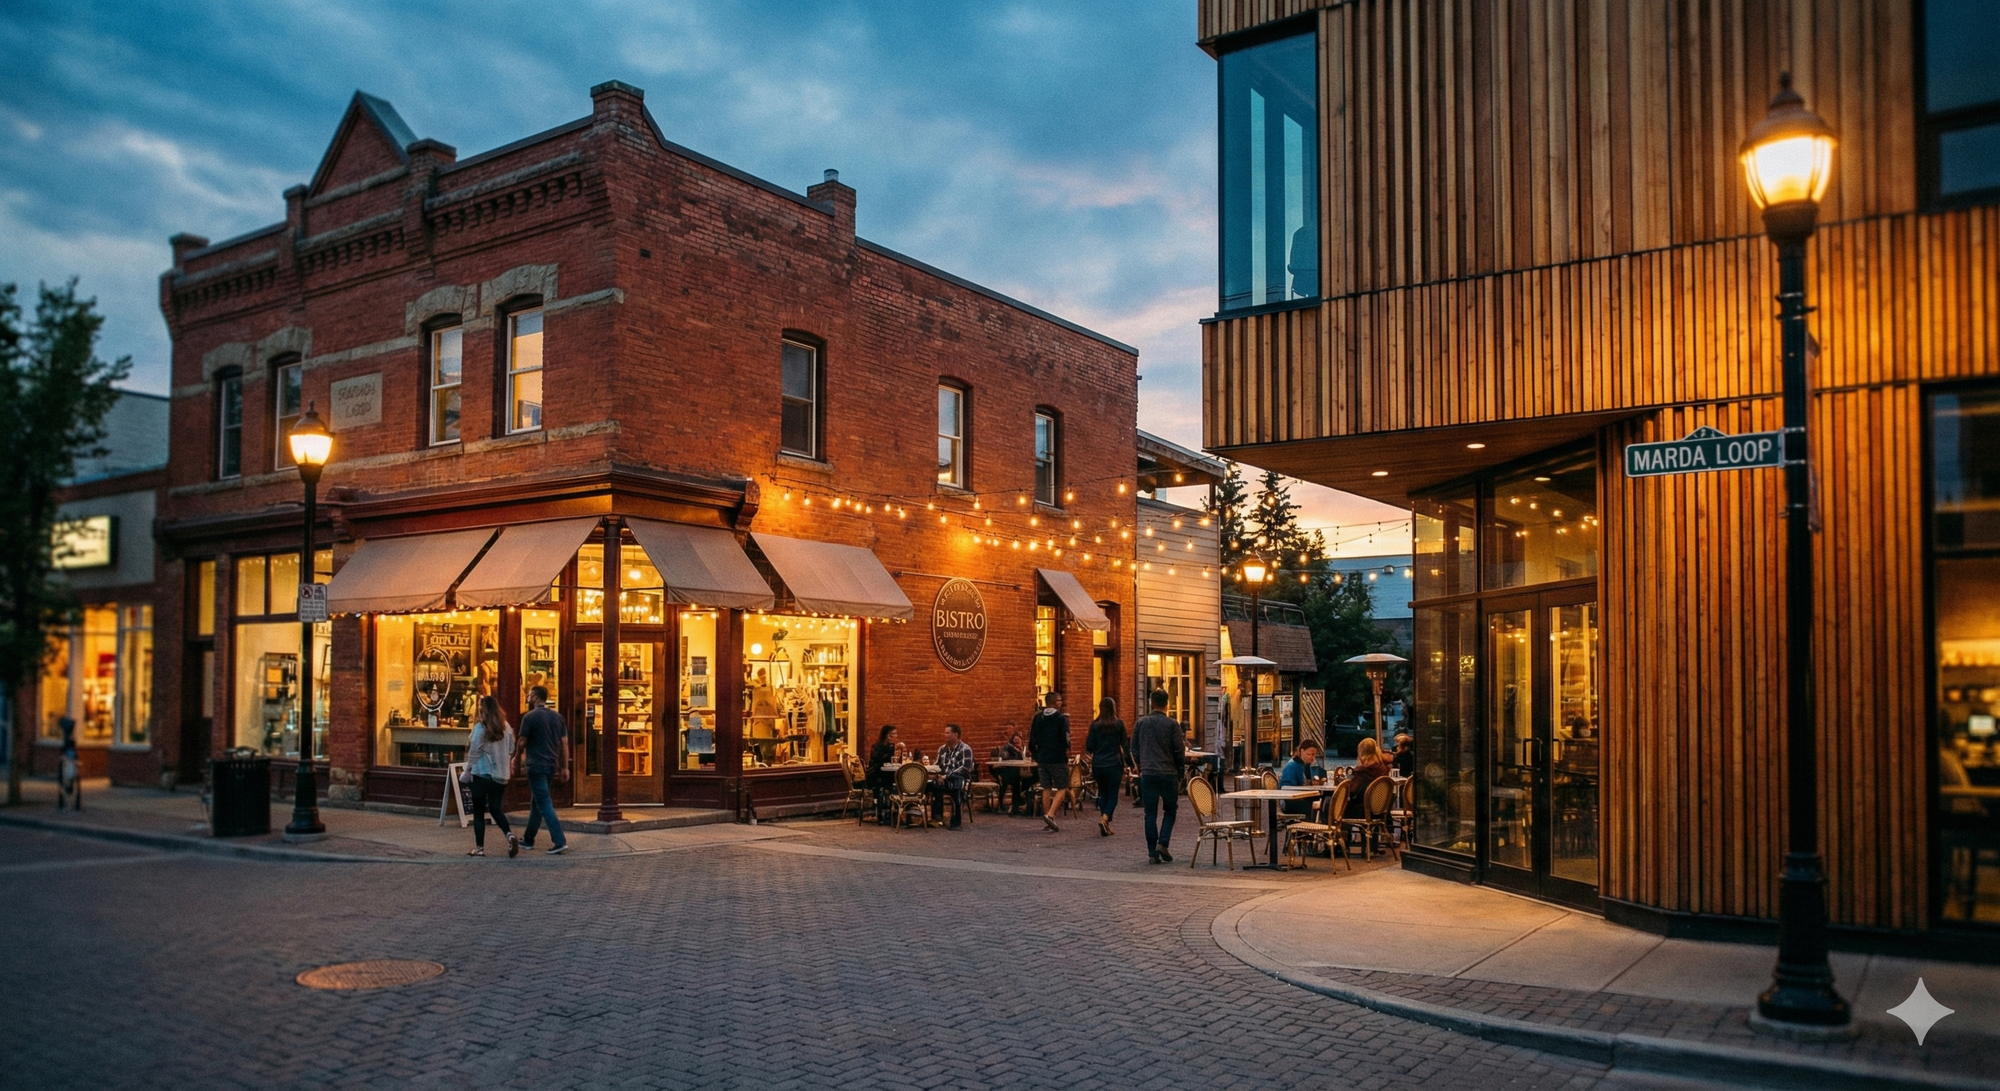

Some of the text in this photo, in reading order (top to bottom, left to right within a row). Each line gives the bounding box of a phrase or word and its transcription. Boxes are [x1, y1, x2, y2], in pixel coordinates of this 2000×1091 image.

[1634, 439, 1772, 471] MARDA LOOP
[936, 609, 984, 629] BISTRO
